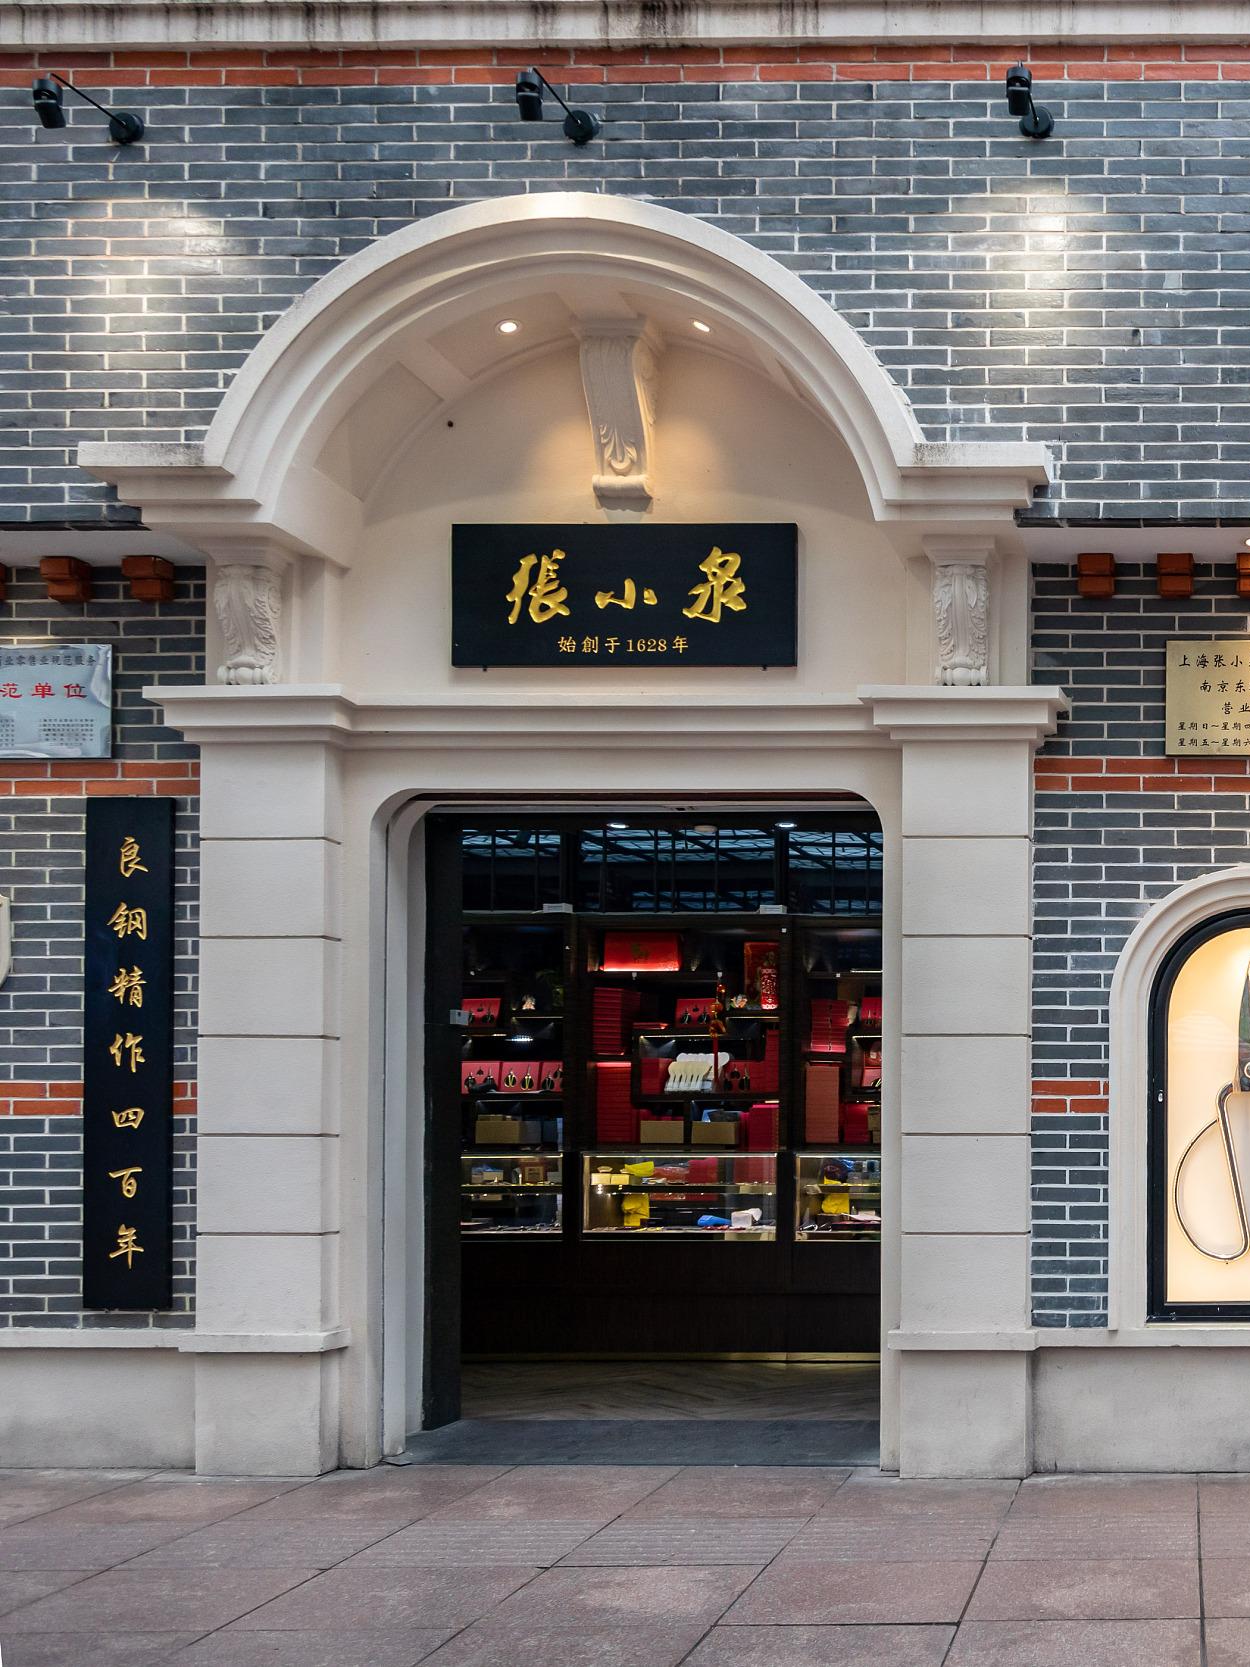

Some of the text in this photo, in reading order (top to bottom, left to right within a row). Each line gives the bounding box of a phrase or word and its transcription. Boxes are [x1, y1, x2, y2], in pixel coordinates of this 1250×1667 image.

[557, 636, 689, 654] 始創于1628年
[107, 836, 149, 1270] 良钢精作四百年
